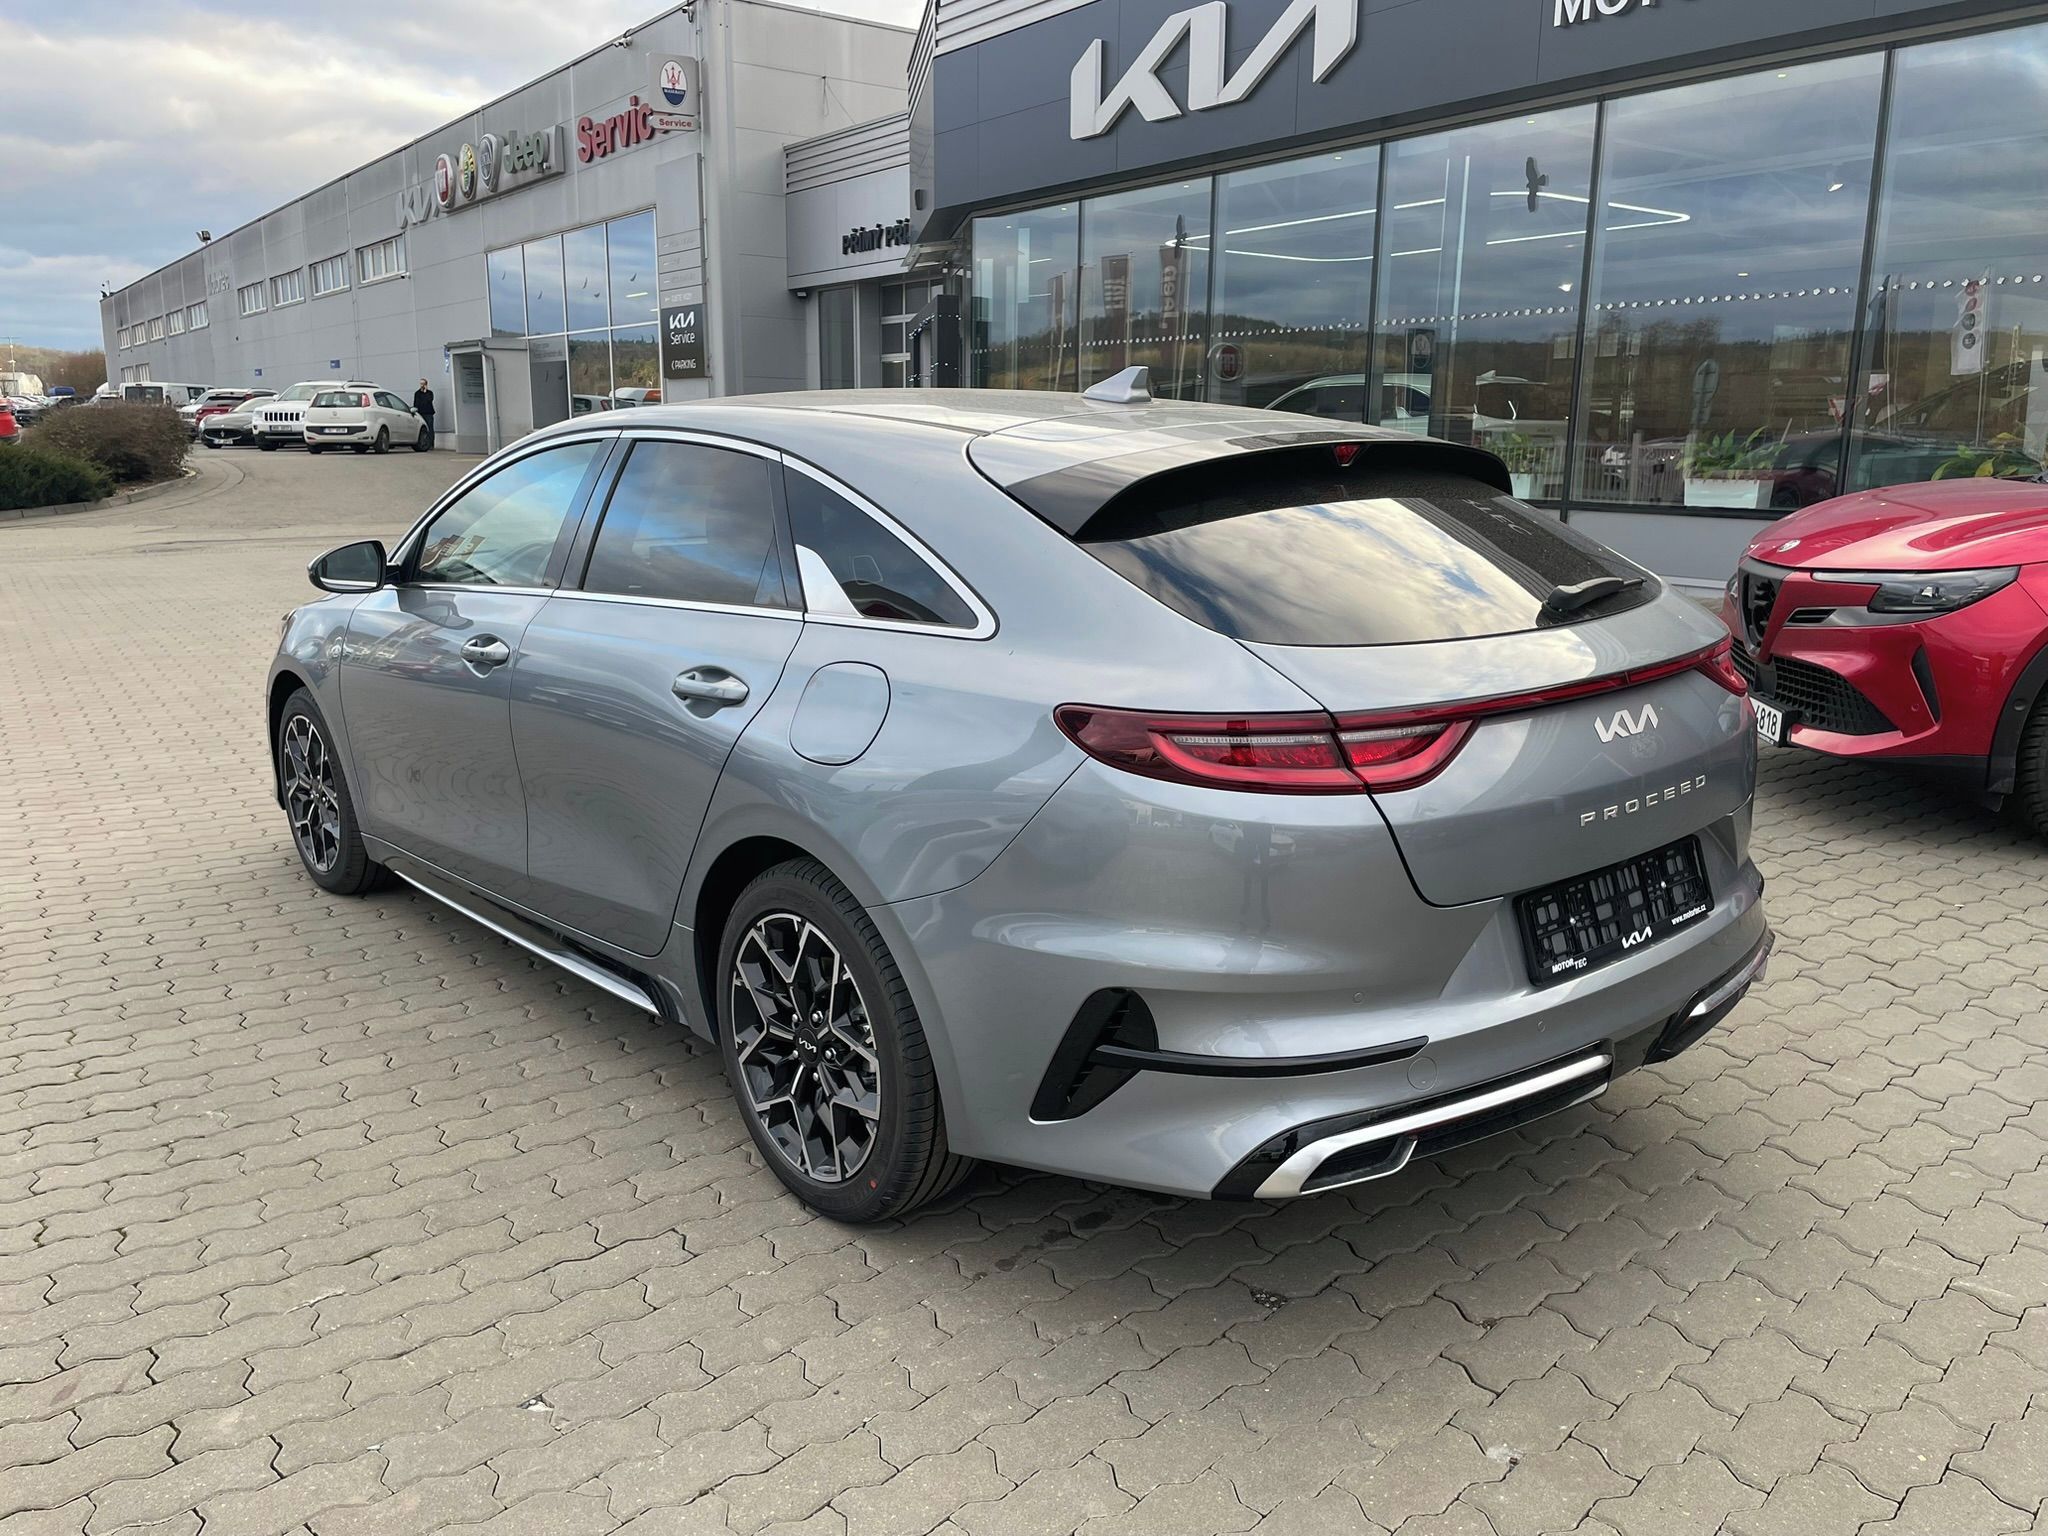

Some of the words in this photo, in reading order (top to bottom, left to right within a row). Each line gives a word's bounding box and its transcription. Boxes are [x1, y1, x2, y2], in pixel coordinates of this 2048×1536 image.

[1070, 0, 1357, 140] KIA
[577, 94, 656, 163] Servic
[658, 119, 693, 128] Service
[842, 223, 884, 256] PŘÍMÝ
[669, 311, 695, 330] KIA
[670, 331, 696, 346] Service
[1594, 703, 1659, 743] KIA
[1580, 774, 1706, 828] PROCEED
[1621, 926, 1653, 949] KIA
[1551, 957, 1575, 974] MOTOR
[1574, 957, 1588, 970] TEC
